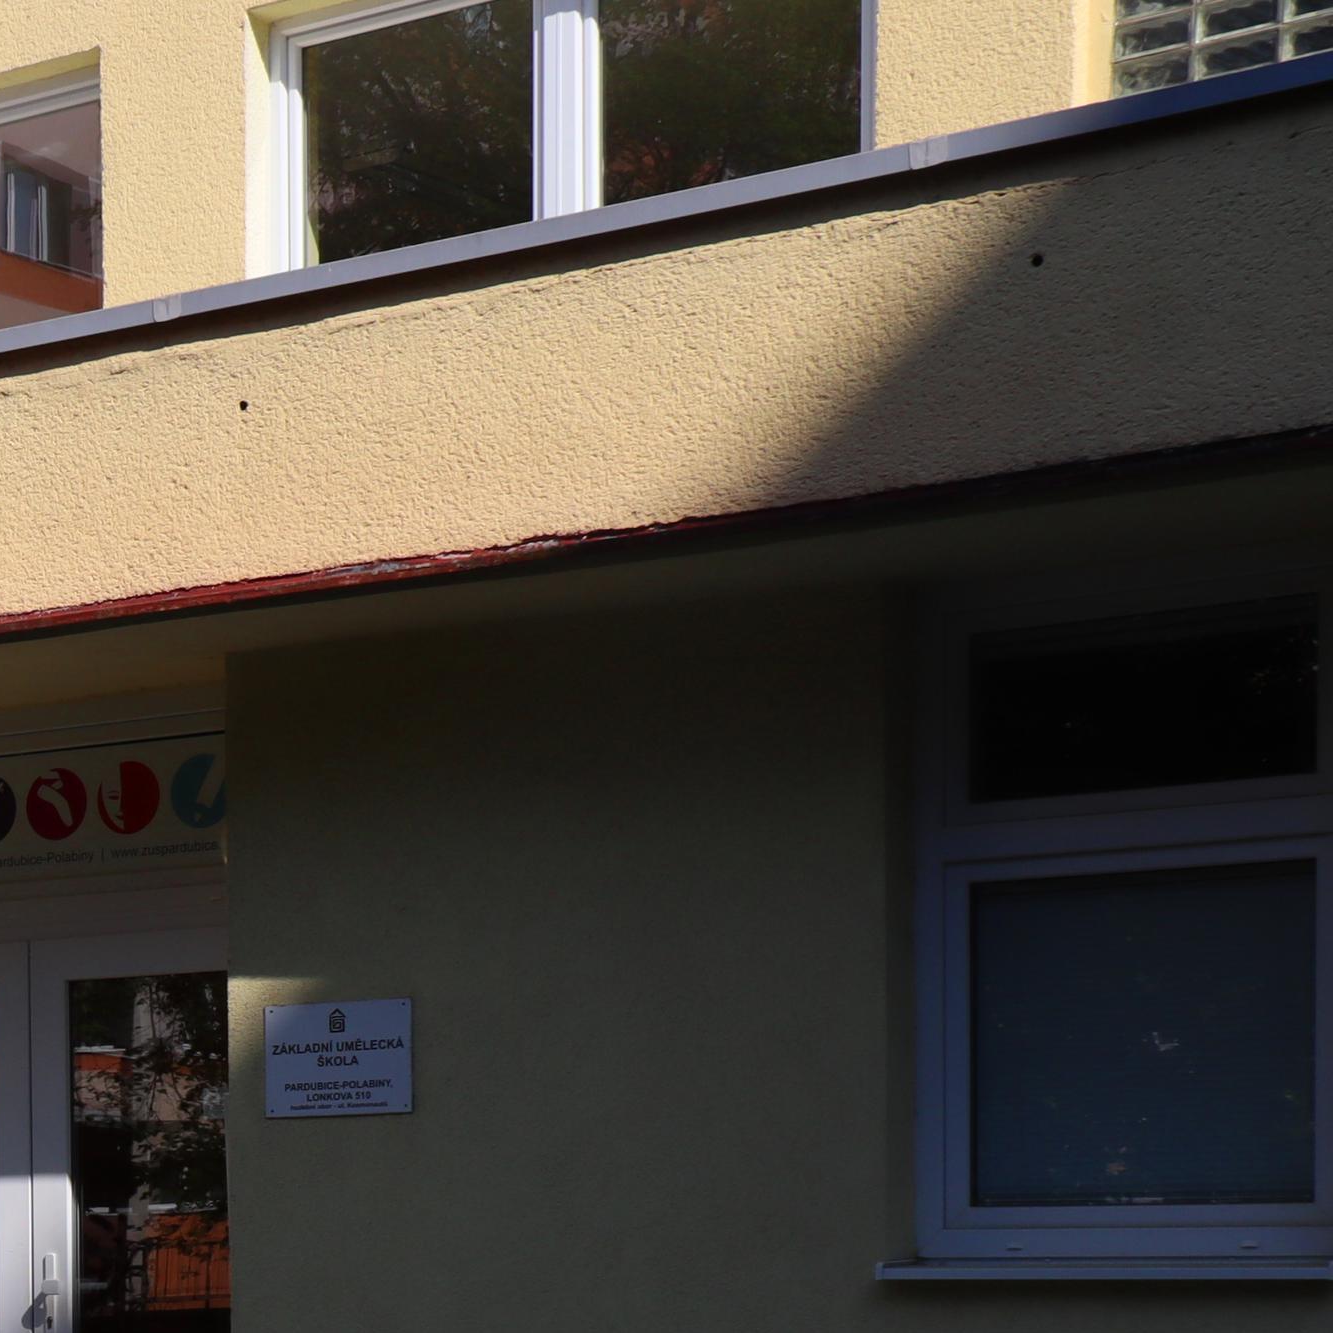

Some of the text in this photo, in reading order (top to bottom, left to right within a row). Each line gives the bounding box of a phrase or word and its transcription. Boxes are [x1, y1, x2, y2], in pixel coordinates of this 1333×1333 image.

[110, 840, 220, 858] www.zuspardubice.
[272, 1037, 404, 1055] ZÁKLADNÍ UMĚLECKÁ
[317, 1055, 359, 1067] ŠKOLA
[307, 1090, 372, 1102] LONKOVA 510
